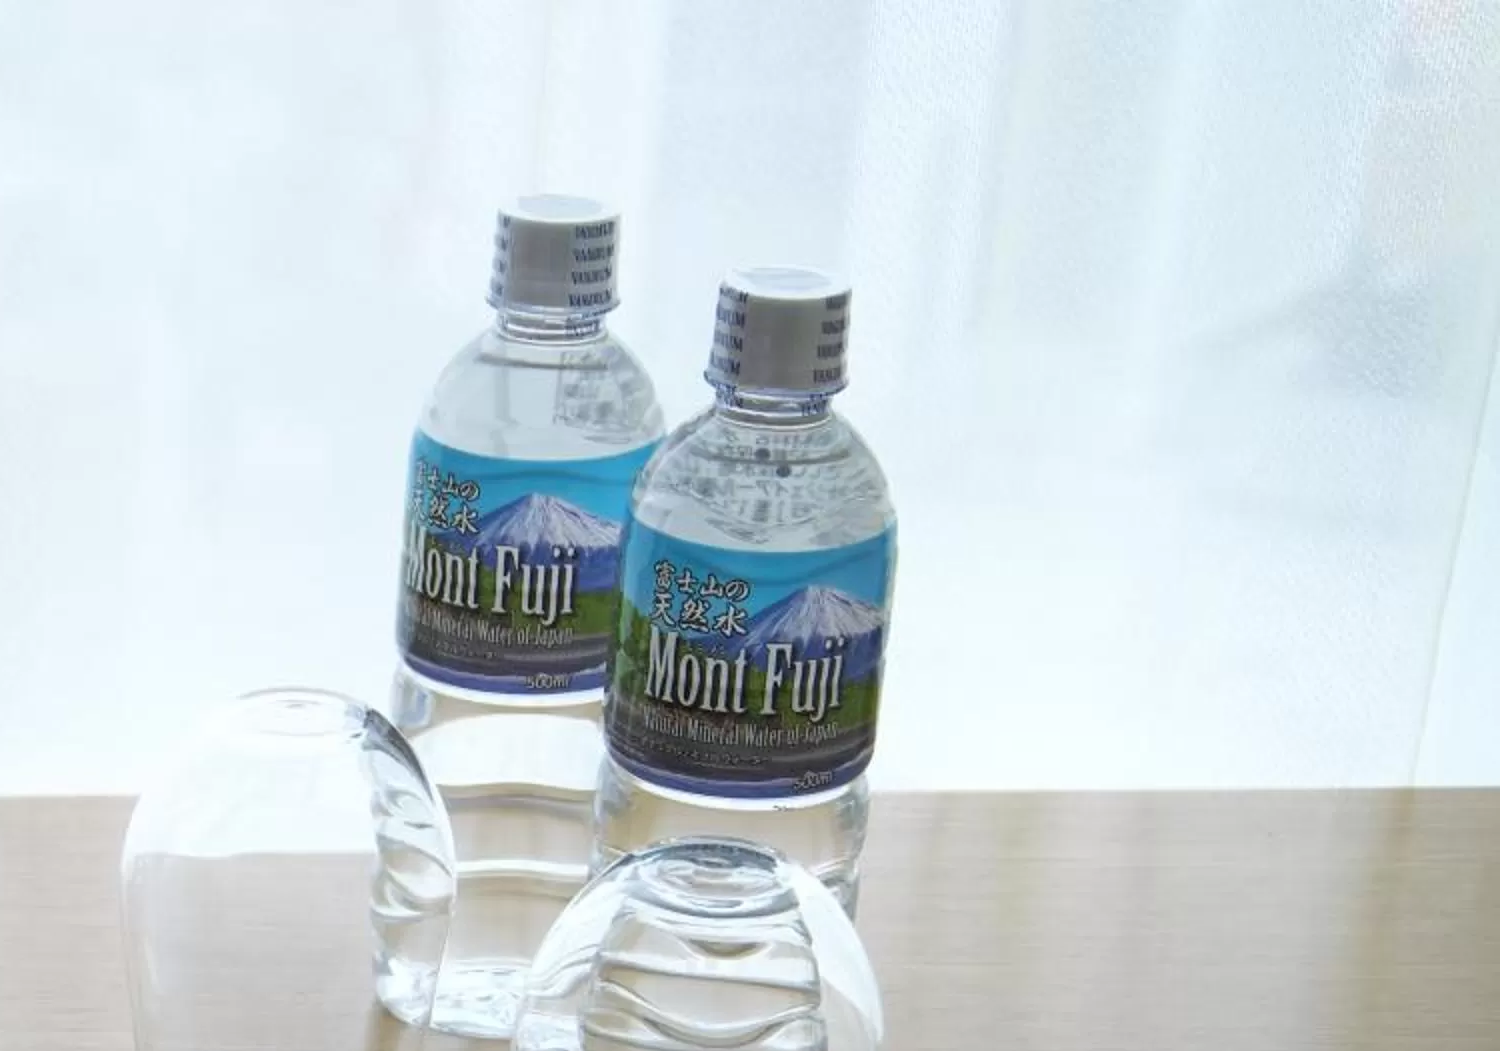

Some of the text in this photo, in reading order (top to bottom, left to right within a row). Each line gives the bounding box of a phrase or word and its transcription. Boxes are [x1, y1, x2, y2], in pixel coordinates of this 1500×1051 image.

[405, 522, 573, 625] Mont Fuji
[654, 560, 750, 599] 富士山の
[651, 591, 748, 637] 天然水
[644, 624, 844, 722] Mont Fuji
